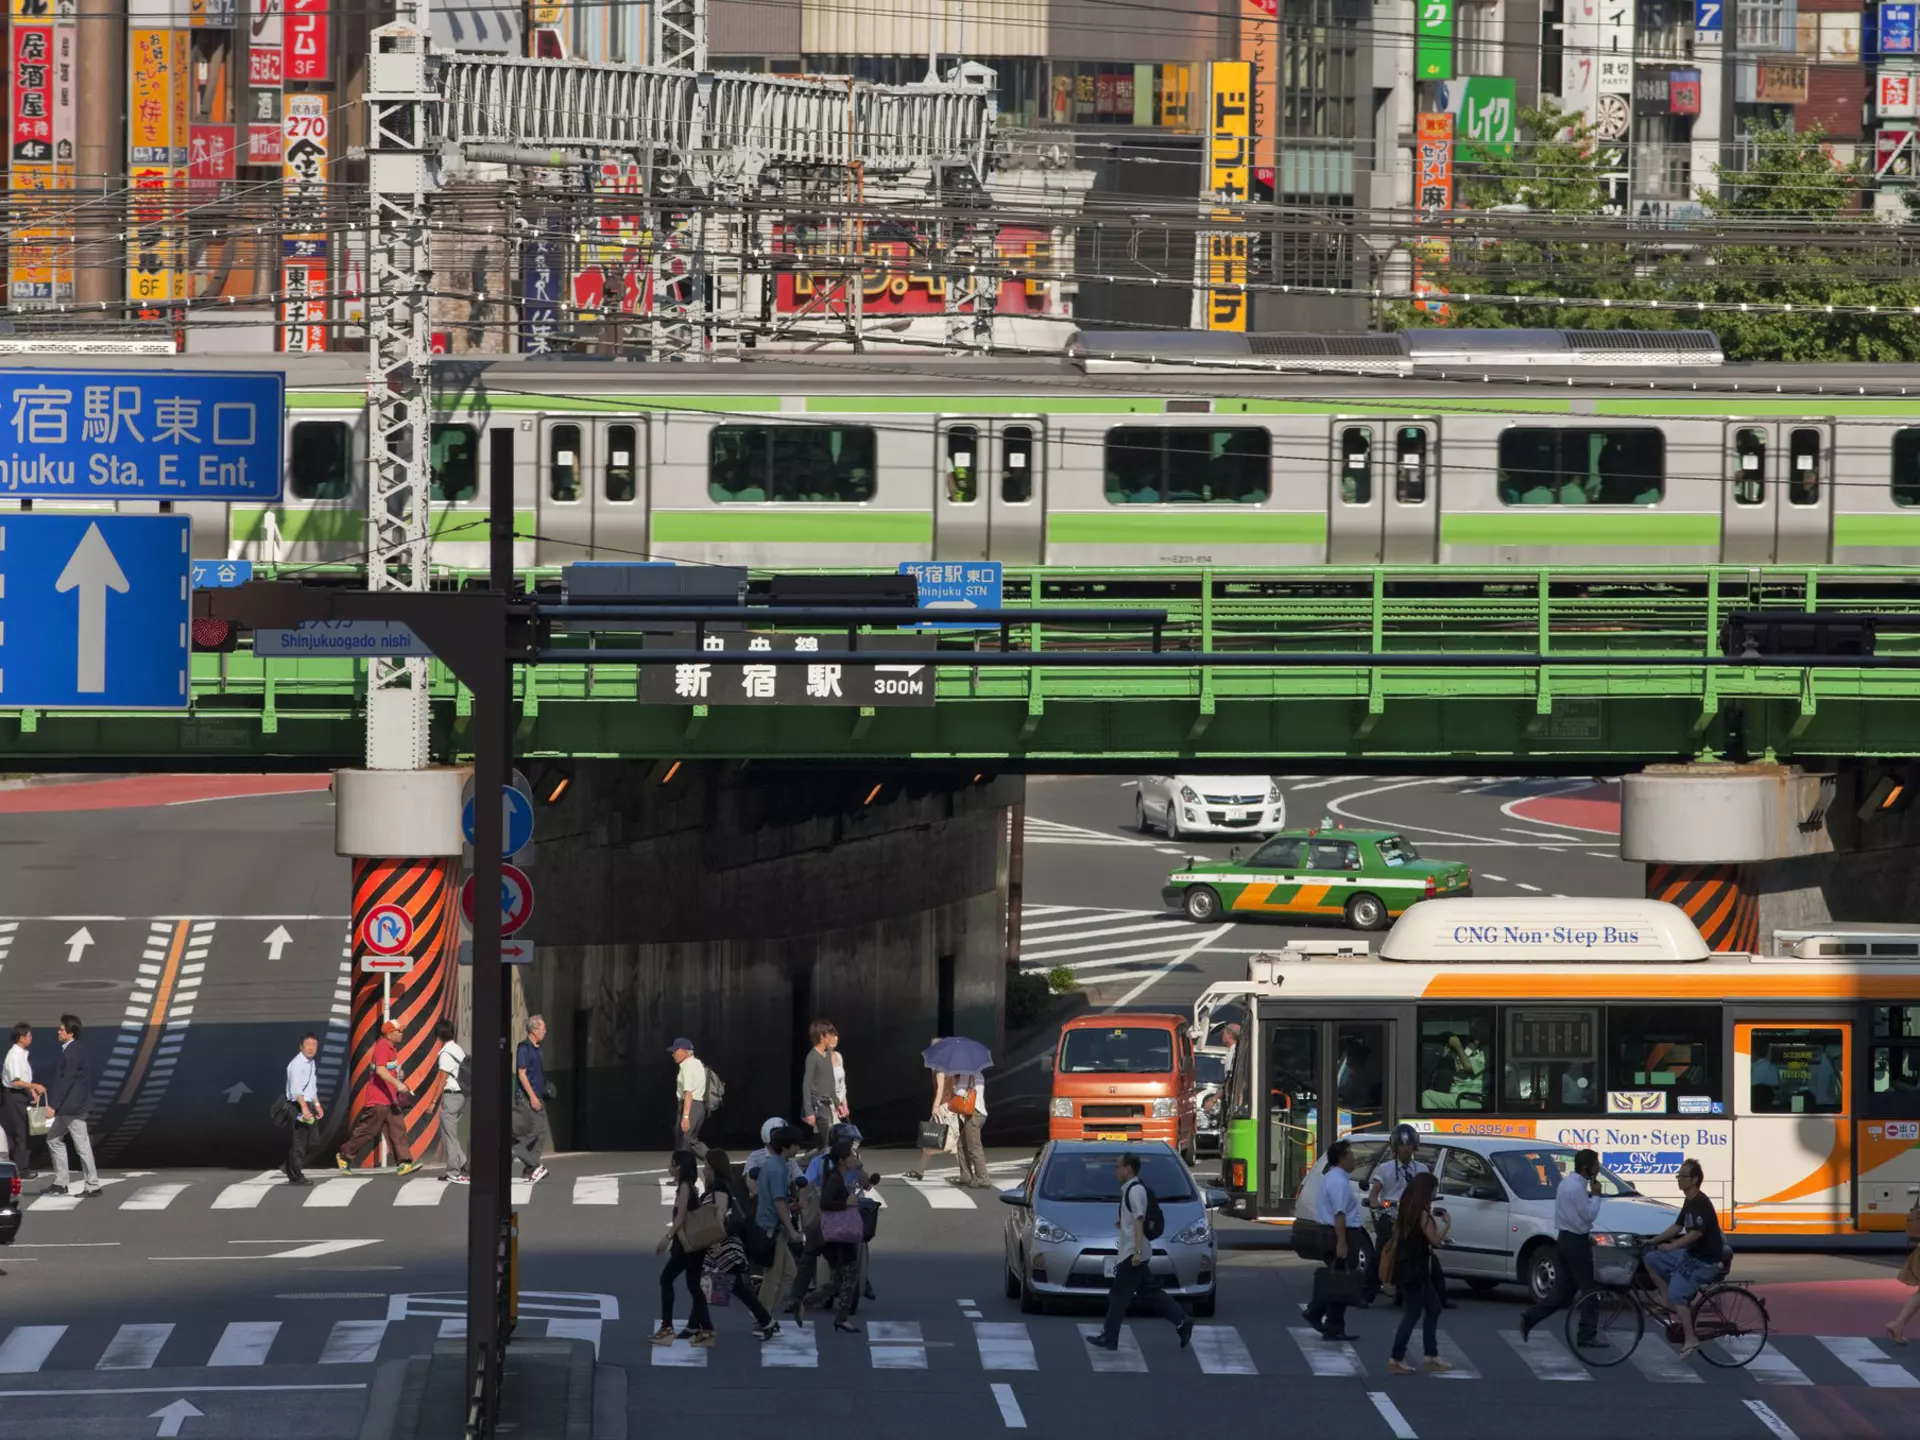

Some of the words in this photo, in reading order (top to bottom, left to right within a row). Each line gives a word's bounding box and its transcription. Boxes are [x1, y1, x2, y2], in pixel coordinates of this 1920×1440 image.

[1424, 0, 1446, 27] ク
[1699, 3, 1720, 27] 7
[294, 0, 317, 55] コム
[18, 32, 48, 118] 居酒屋
[251, 53, 280, 80] たばこ
[295, 60, 316, 74] 3F
[1602, 63, 1629, 75] 貸切
[287, 116, 326, 138] 270
[1468, 97, 1510, 142] レイク
[21, 142, 46, 158] 4F
[1436, 140, 1447, 179] フリー
[1422, 146, 1434, 183] セット
[139, 278, 160, 296] 6F
[0, 384, 256, 446] 宿駅東口
[89, 453, 144, 487] Sta.
[159, 454, 186, 487] E.
[200, 455, 255, 488] Ent.
[965, 586, 987, 596] STN
[281, 634, 376, 652] Shinjukuogado
[381, 634, 411, 648] nishi
[675, 663, 843, 698] 新宿駅
[874, 679, 923, 695] 300M
[1454, 926, 1498, 944] CNG
[1603, 926, 1639, 944] Bus
[1558, 1128, 1600, 1145] CNG
[1696, 1129, 1728, 1146] Bus
[1629, 1152, 1657, 1164] CNG
